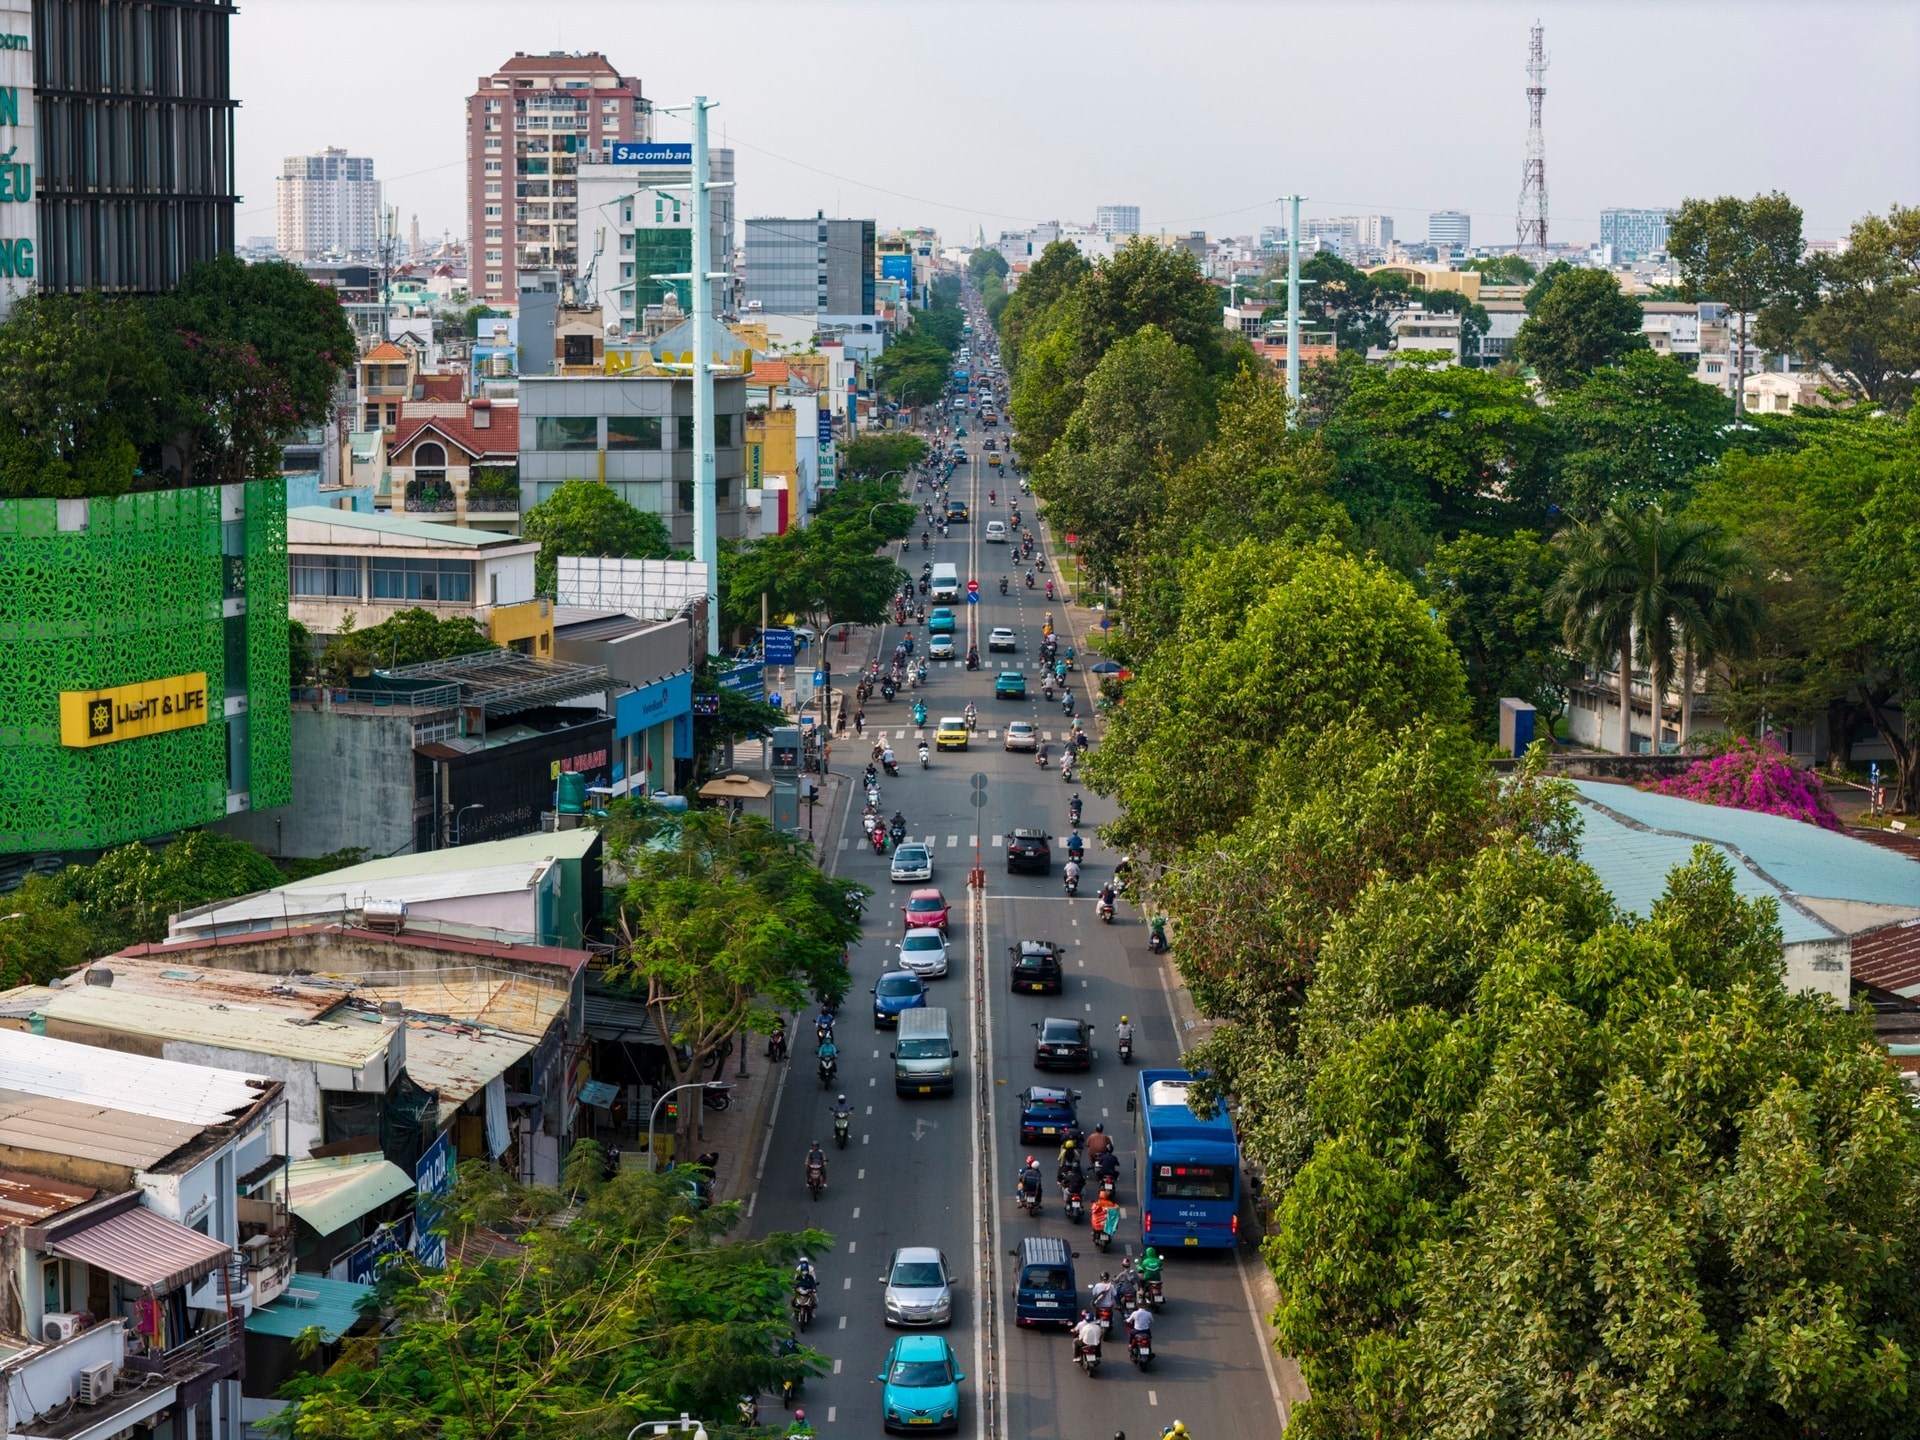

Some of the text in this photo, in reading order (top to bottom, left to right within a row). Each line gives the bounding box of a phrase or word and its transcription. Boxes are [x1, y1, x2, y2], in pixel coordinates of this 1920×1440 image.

[617, 147, 692, 160] Sacomban
[117, 689, 204, 725] LIGHT & LIFE
